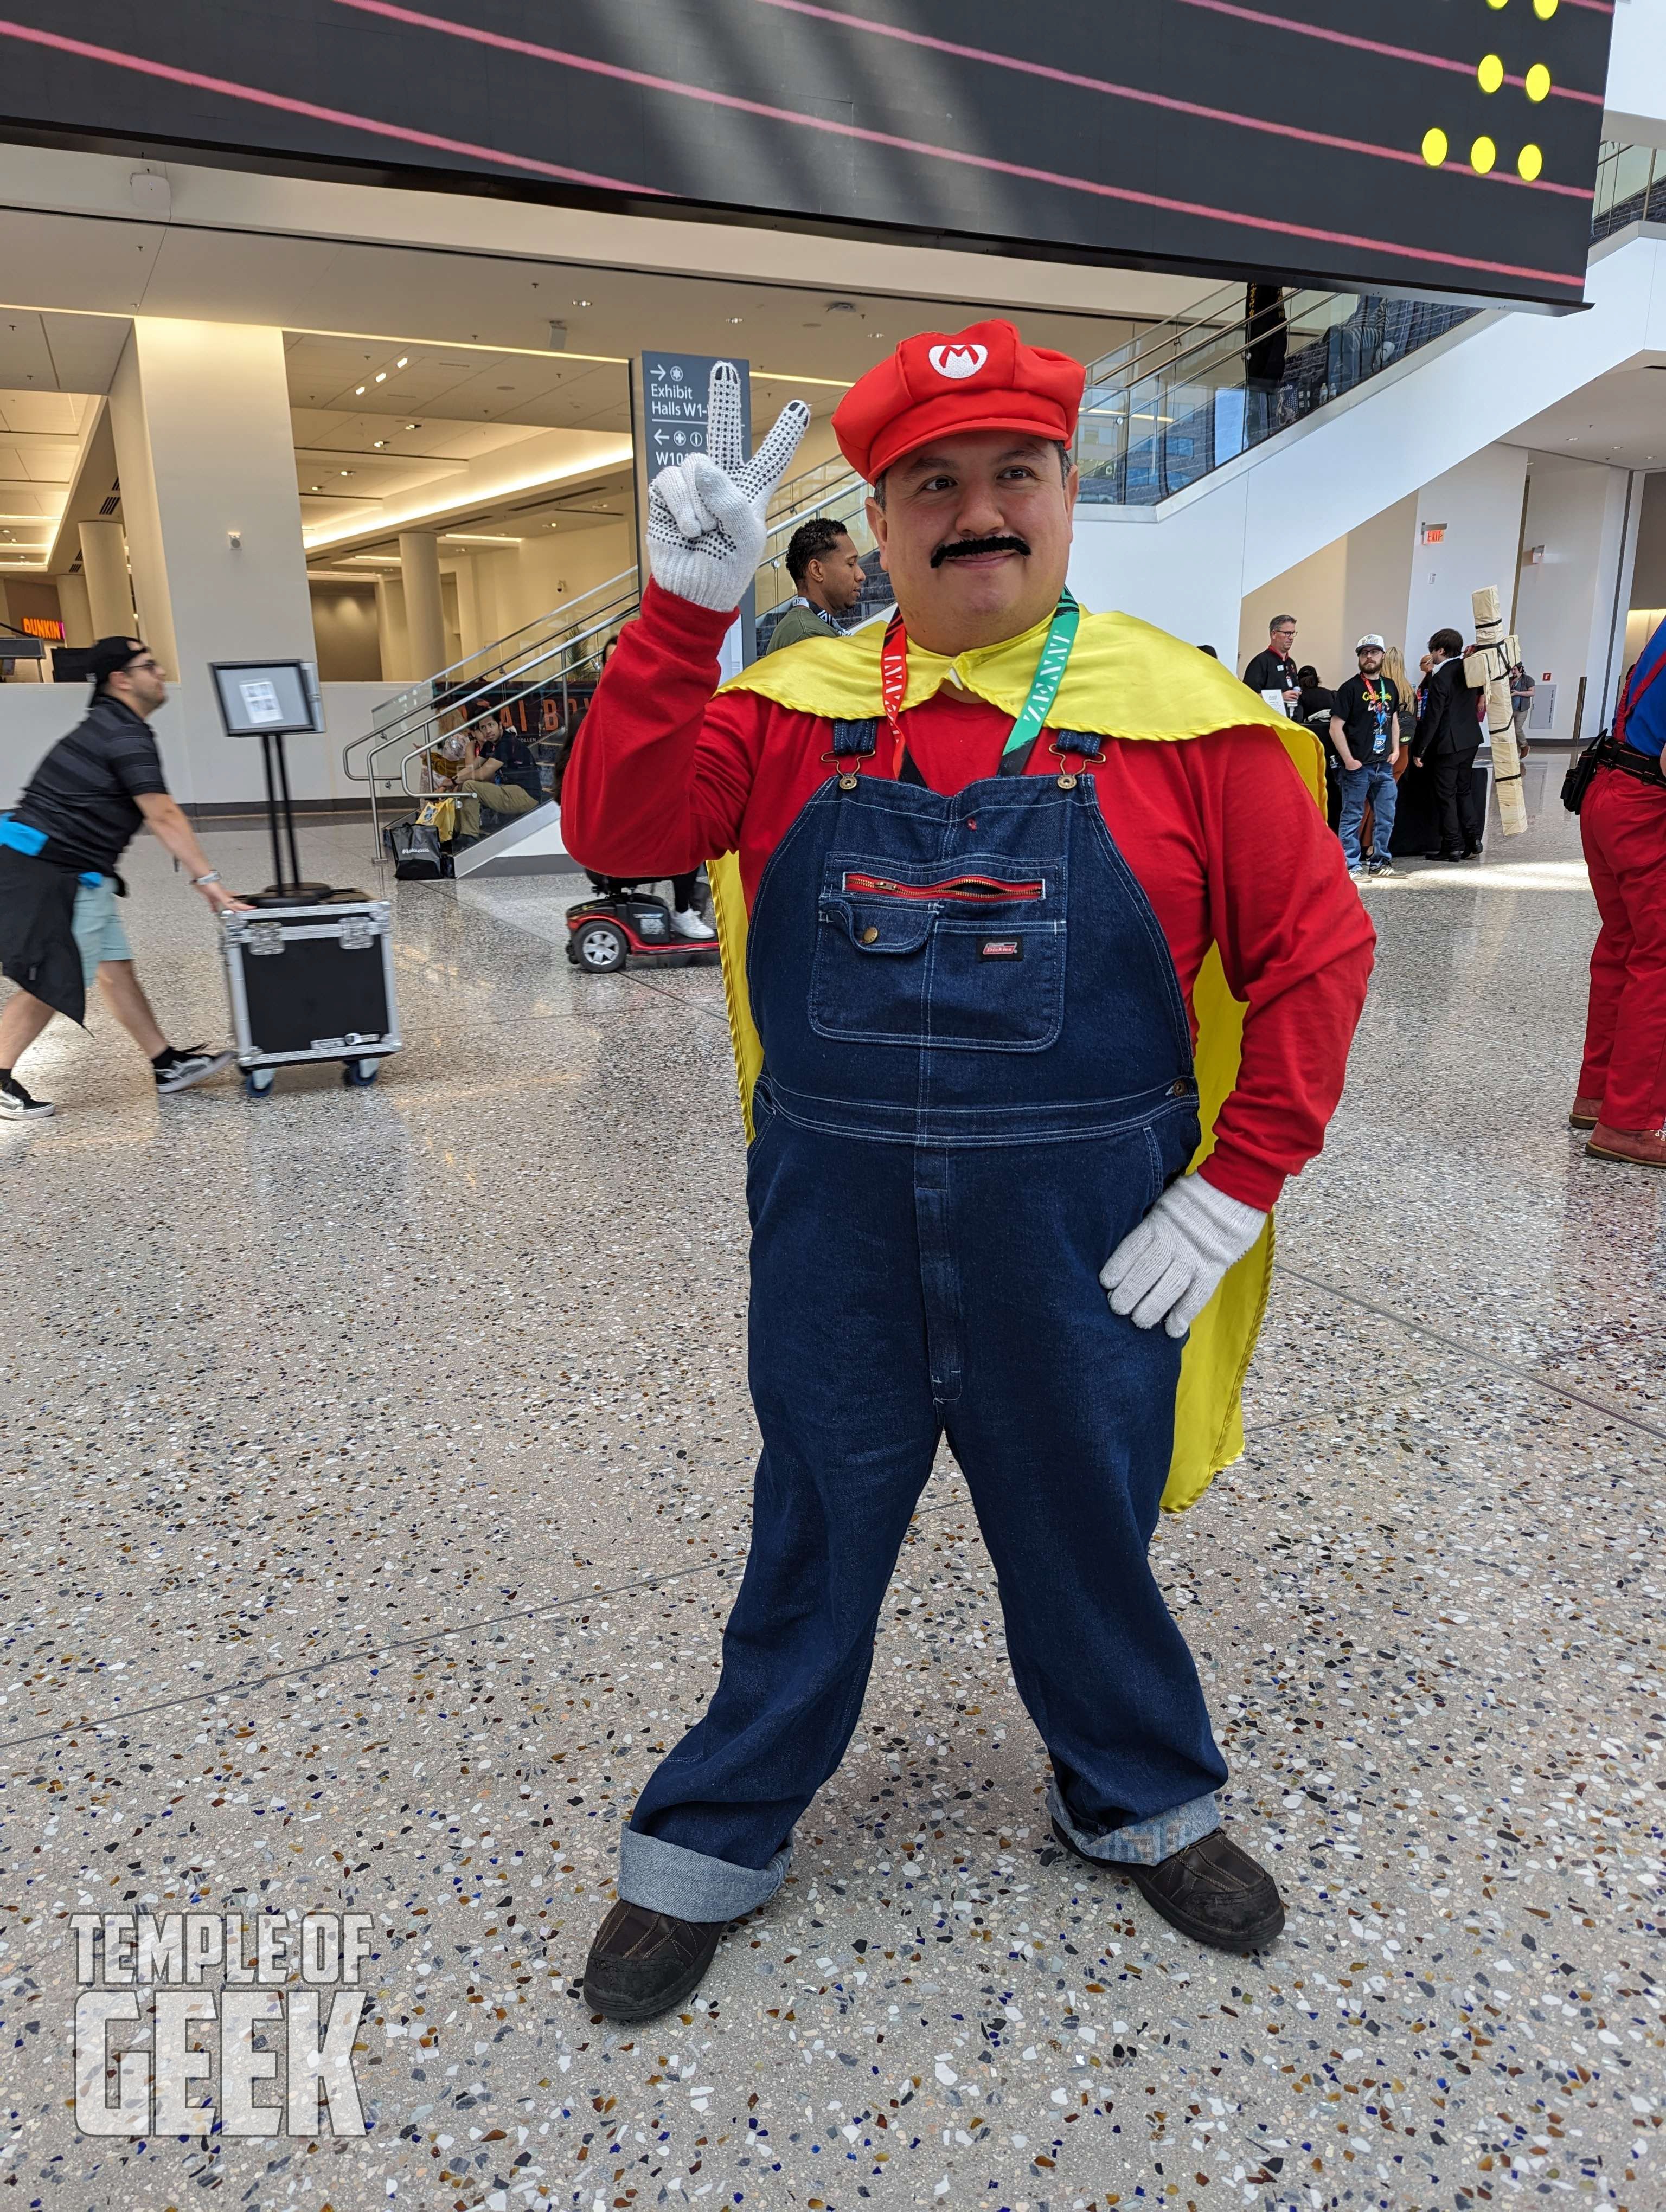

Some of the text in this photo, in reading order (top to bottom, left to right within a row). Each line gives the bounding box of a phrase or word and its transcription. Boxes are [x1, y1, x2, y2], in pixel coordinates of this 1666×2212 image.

[938, 344, 979, 369] M
[651, 383, 693, 400] Exhibit
[652, 401, 709, 417] Halls W1-
[655, 452, 688, 466] W10
